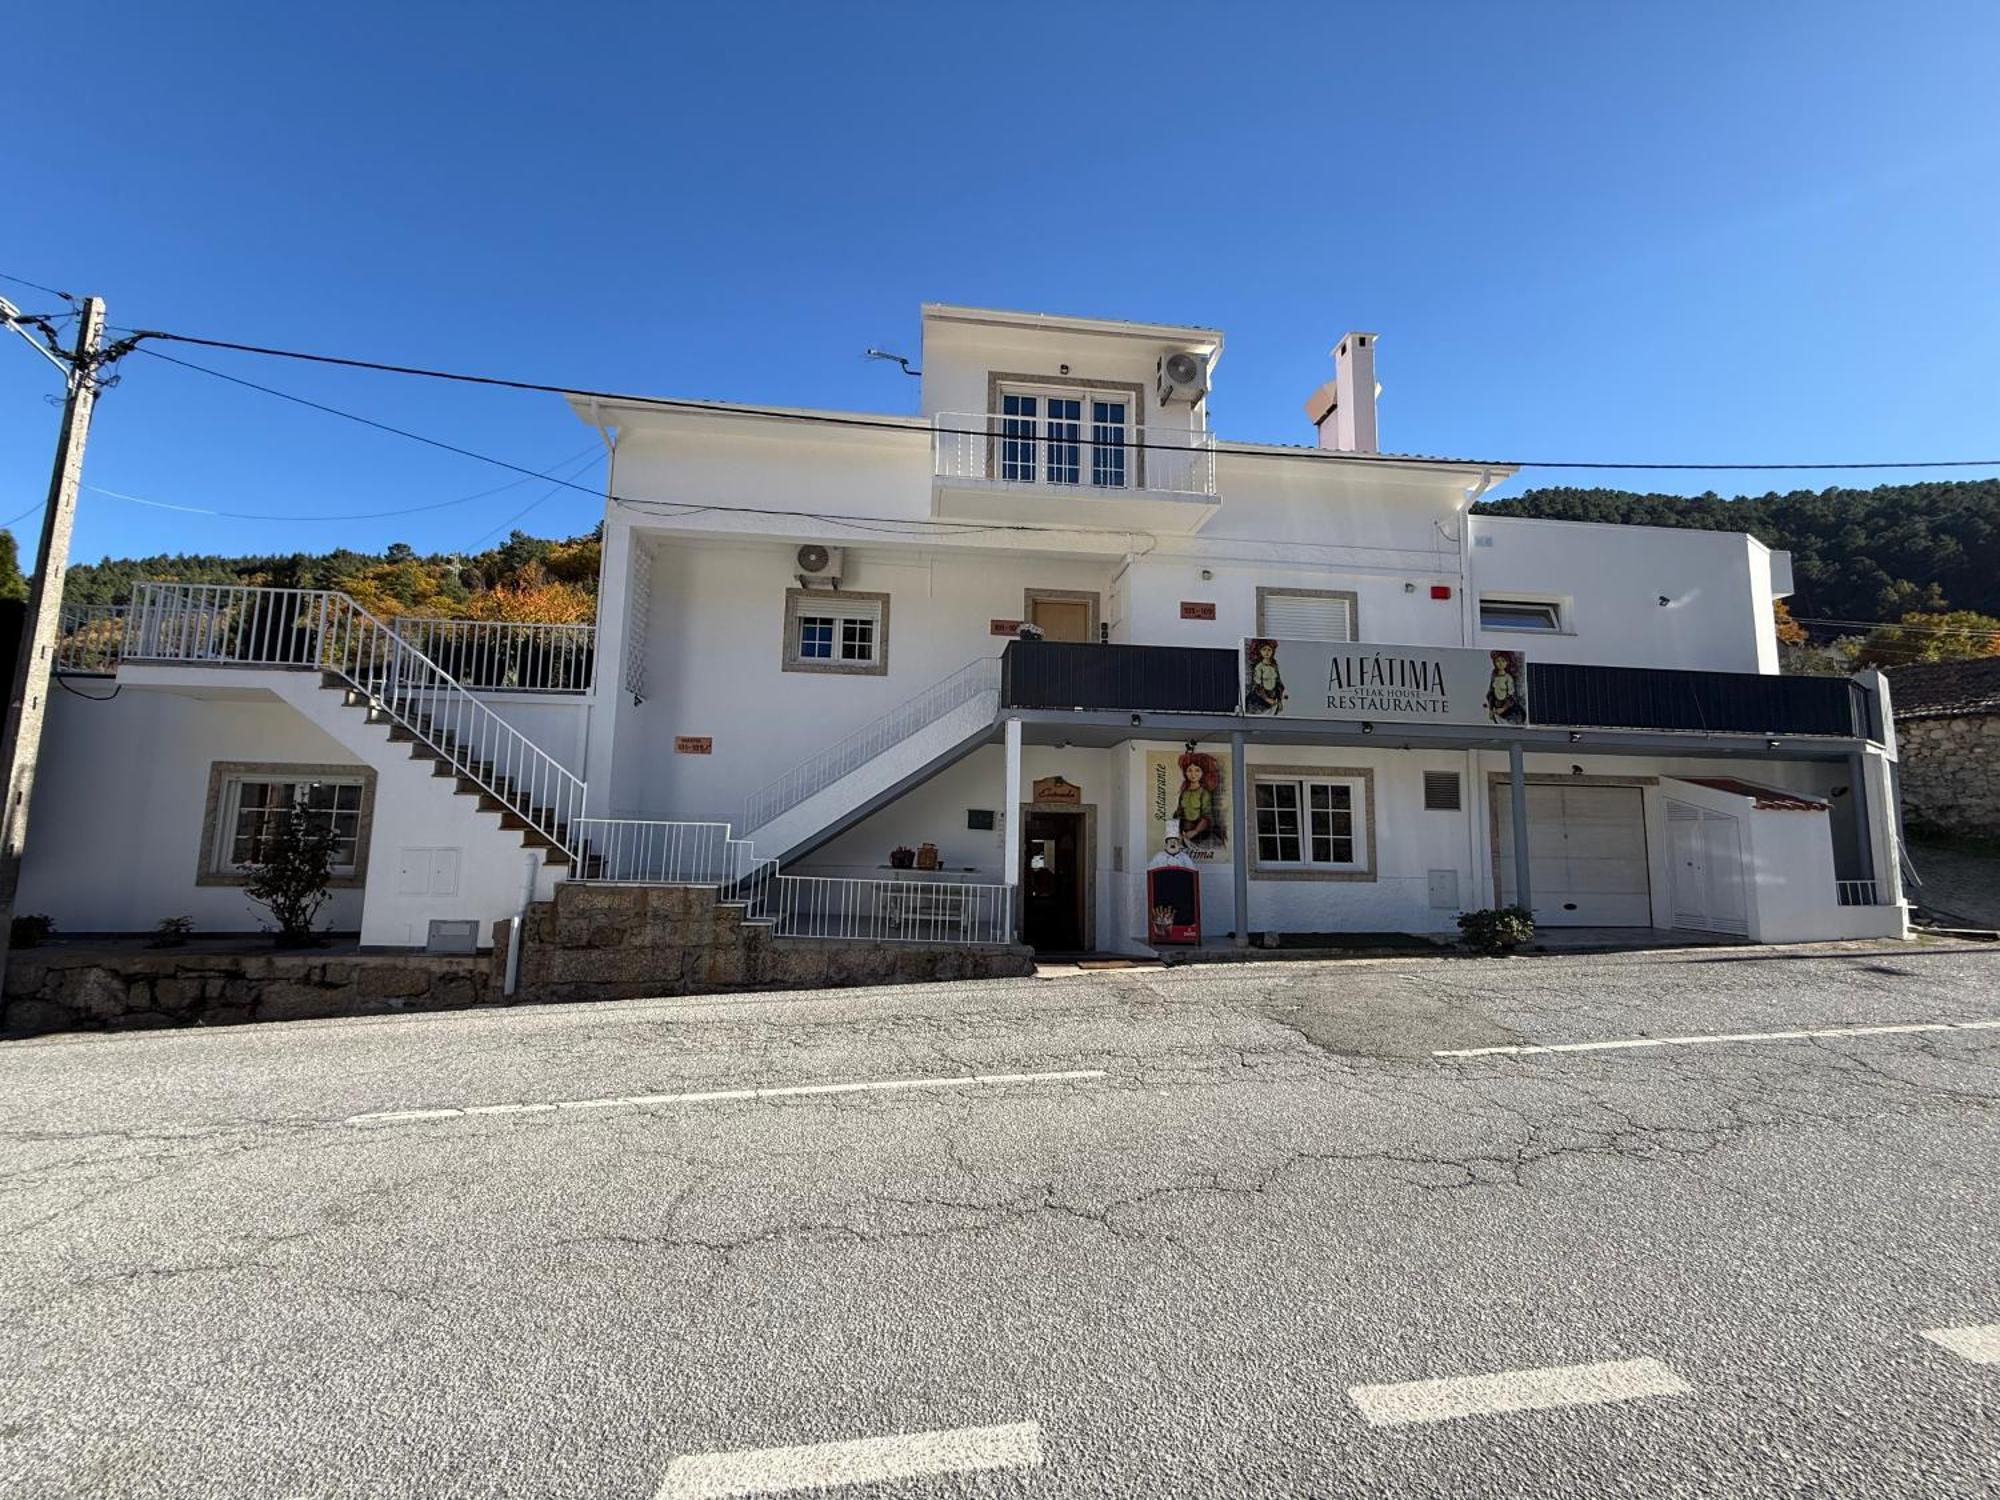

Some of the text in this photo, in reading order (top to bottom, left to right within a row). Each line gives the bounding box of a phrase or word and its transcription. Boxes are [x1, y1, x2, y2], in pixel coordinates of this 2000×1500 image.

[1328, 651, 1446, 697] ALFÁTIMA
[1327, 695, 1449, 713] RESTAURANTE
[1387, 689, 1421, 699] HOUSE
[1154, 763, 1167, 821] Restaurante
